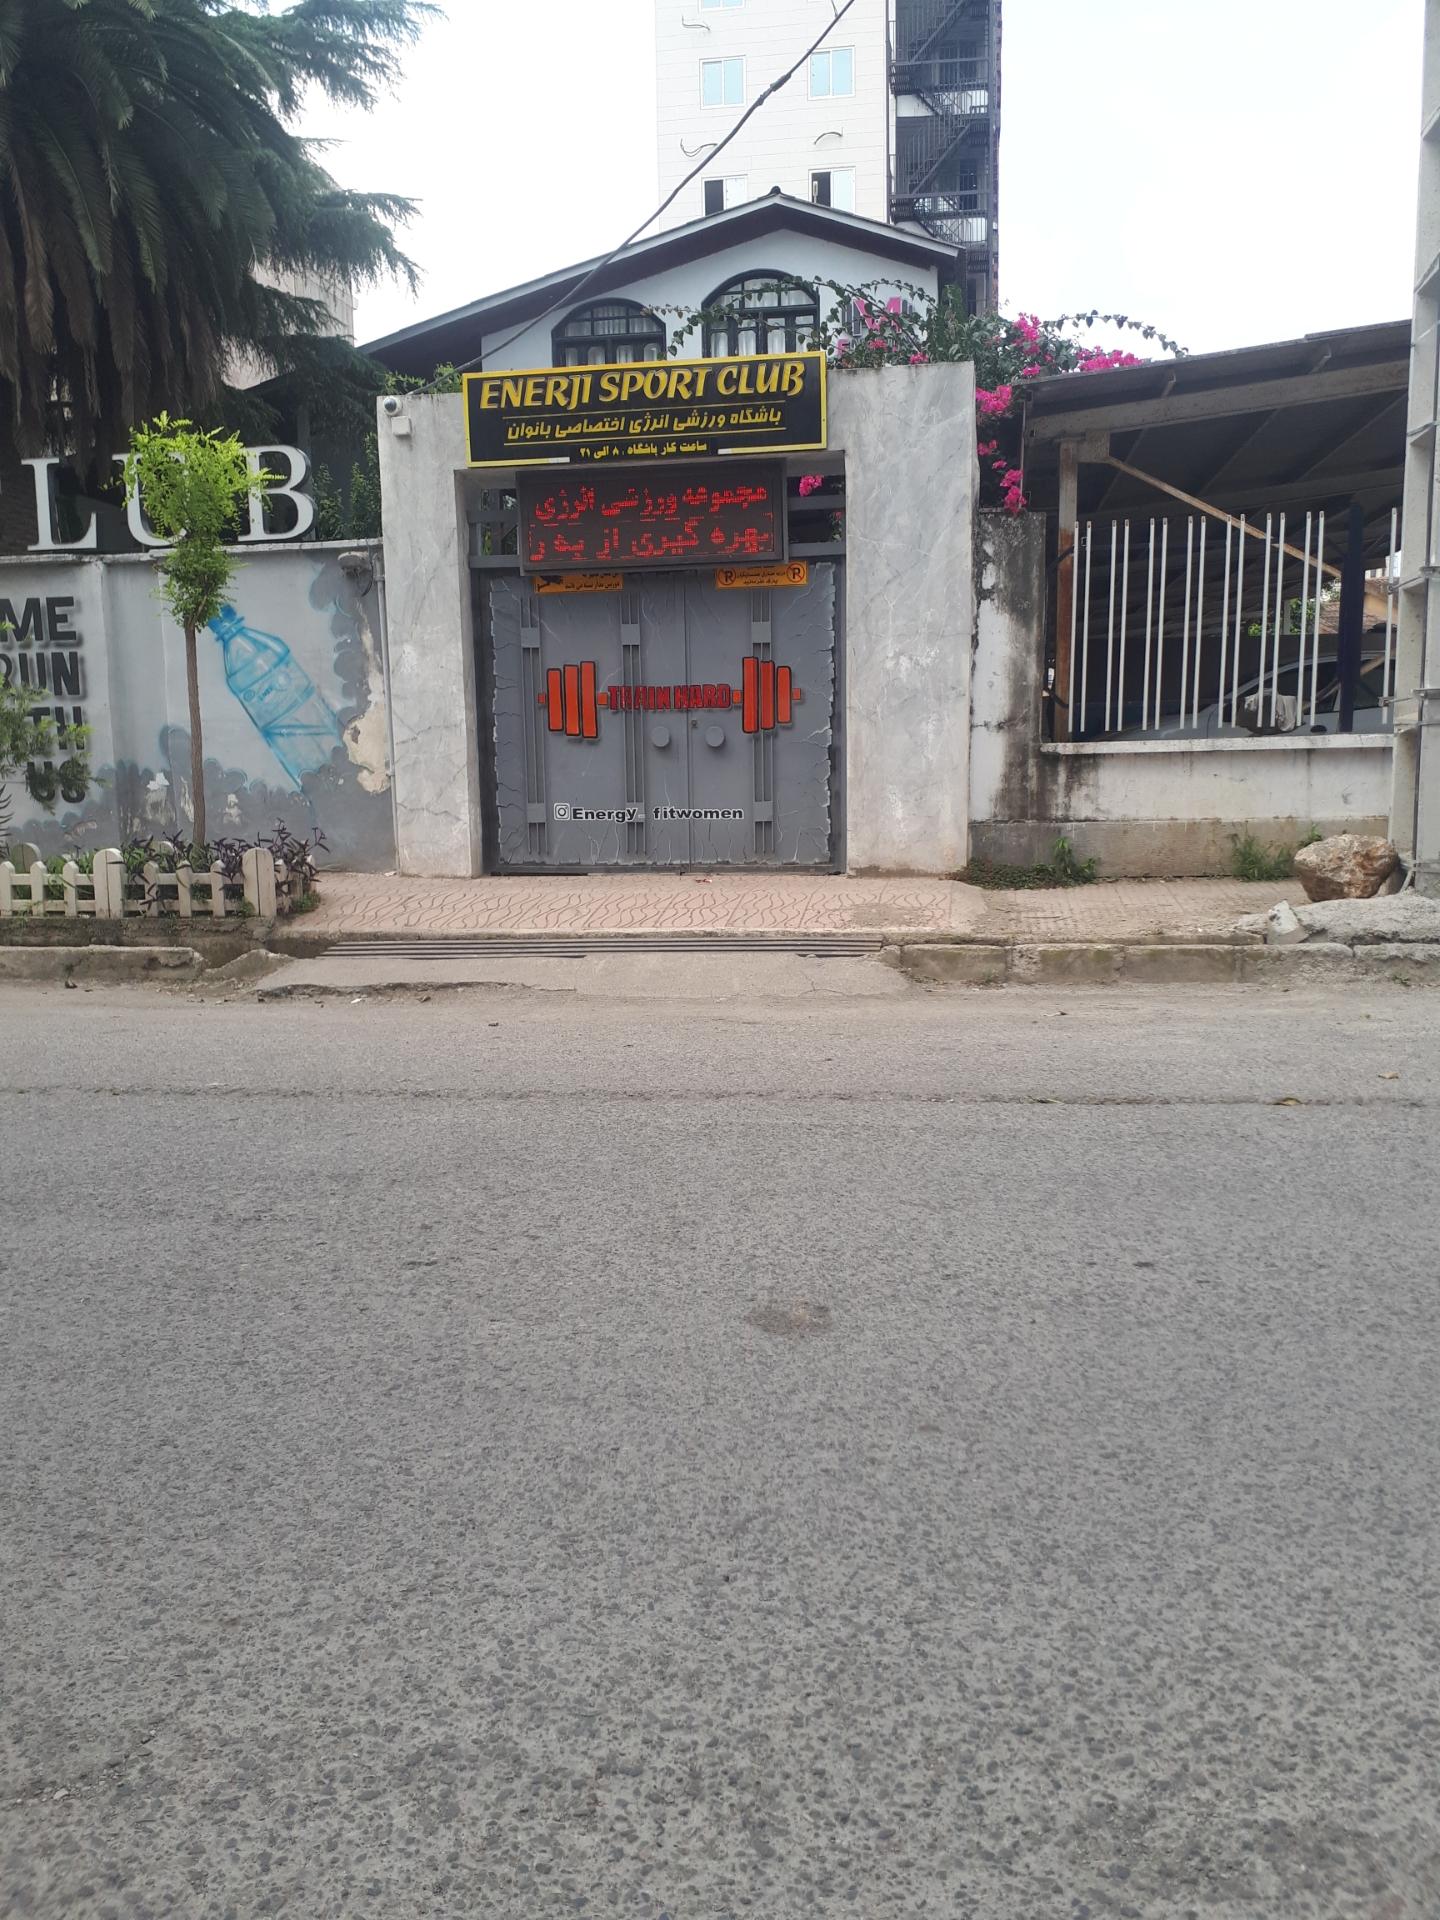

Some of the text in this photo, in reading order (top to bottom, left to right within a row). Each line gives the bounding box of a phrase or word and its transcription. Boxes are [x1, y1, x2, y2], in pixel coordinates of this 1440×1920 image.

[479, 360, 806, 410] ENERJI SPORT CLUB
[507, 405, 782, 441] باشگاه ورزشی انرژی اختصاصی بانوان
[593, 445, 609, 459] الی
[660, 441, 677, 456] کار
[679, 440, 707, 453] ساعت
[682, 486, 768, 513] مجموعه
[607, 683, 732, 710] TRAIN HARD
[653, 807, 744, 821] fitwomen
